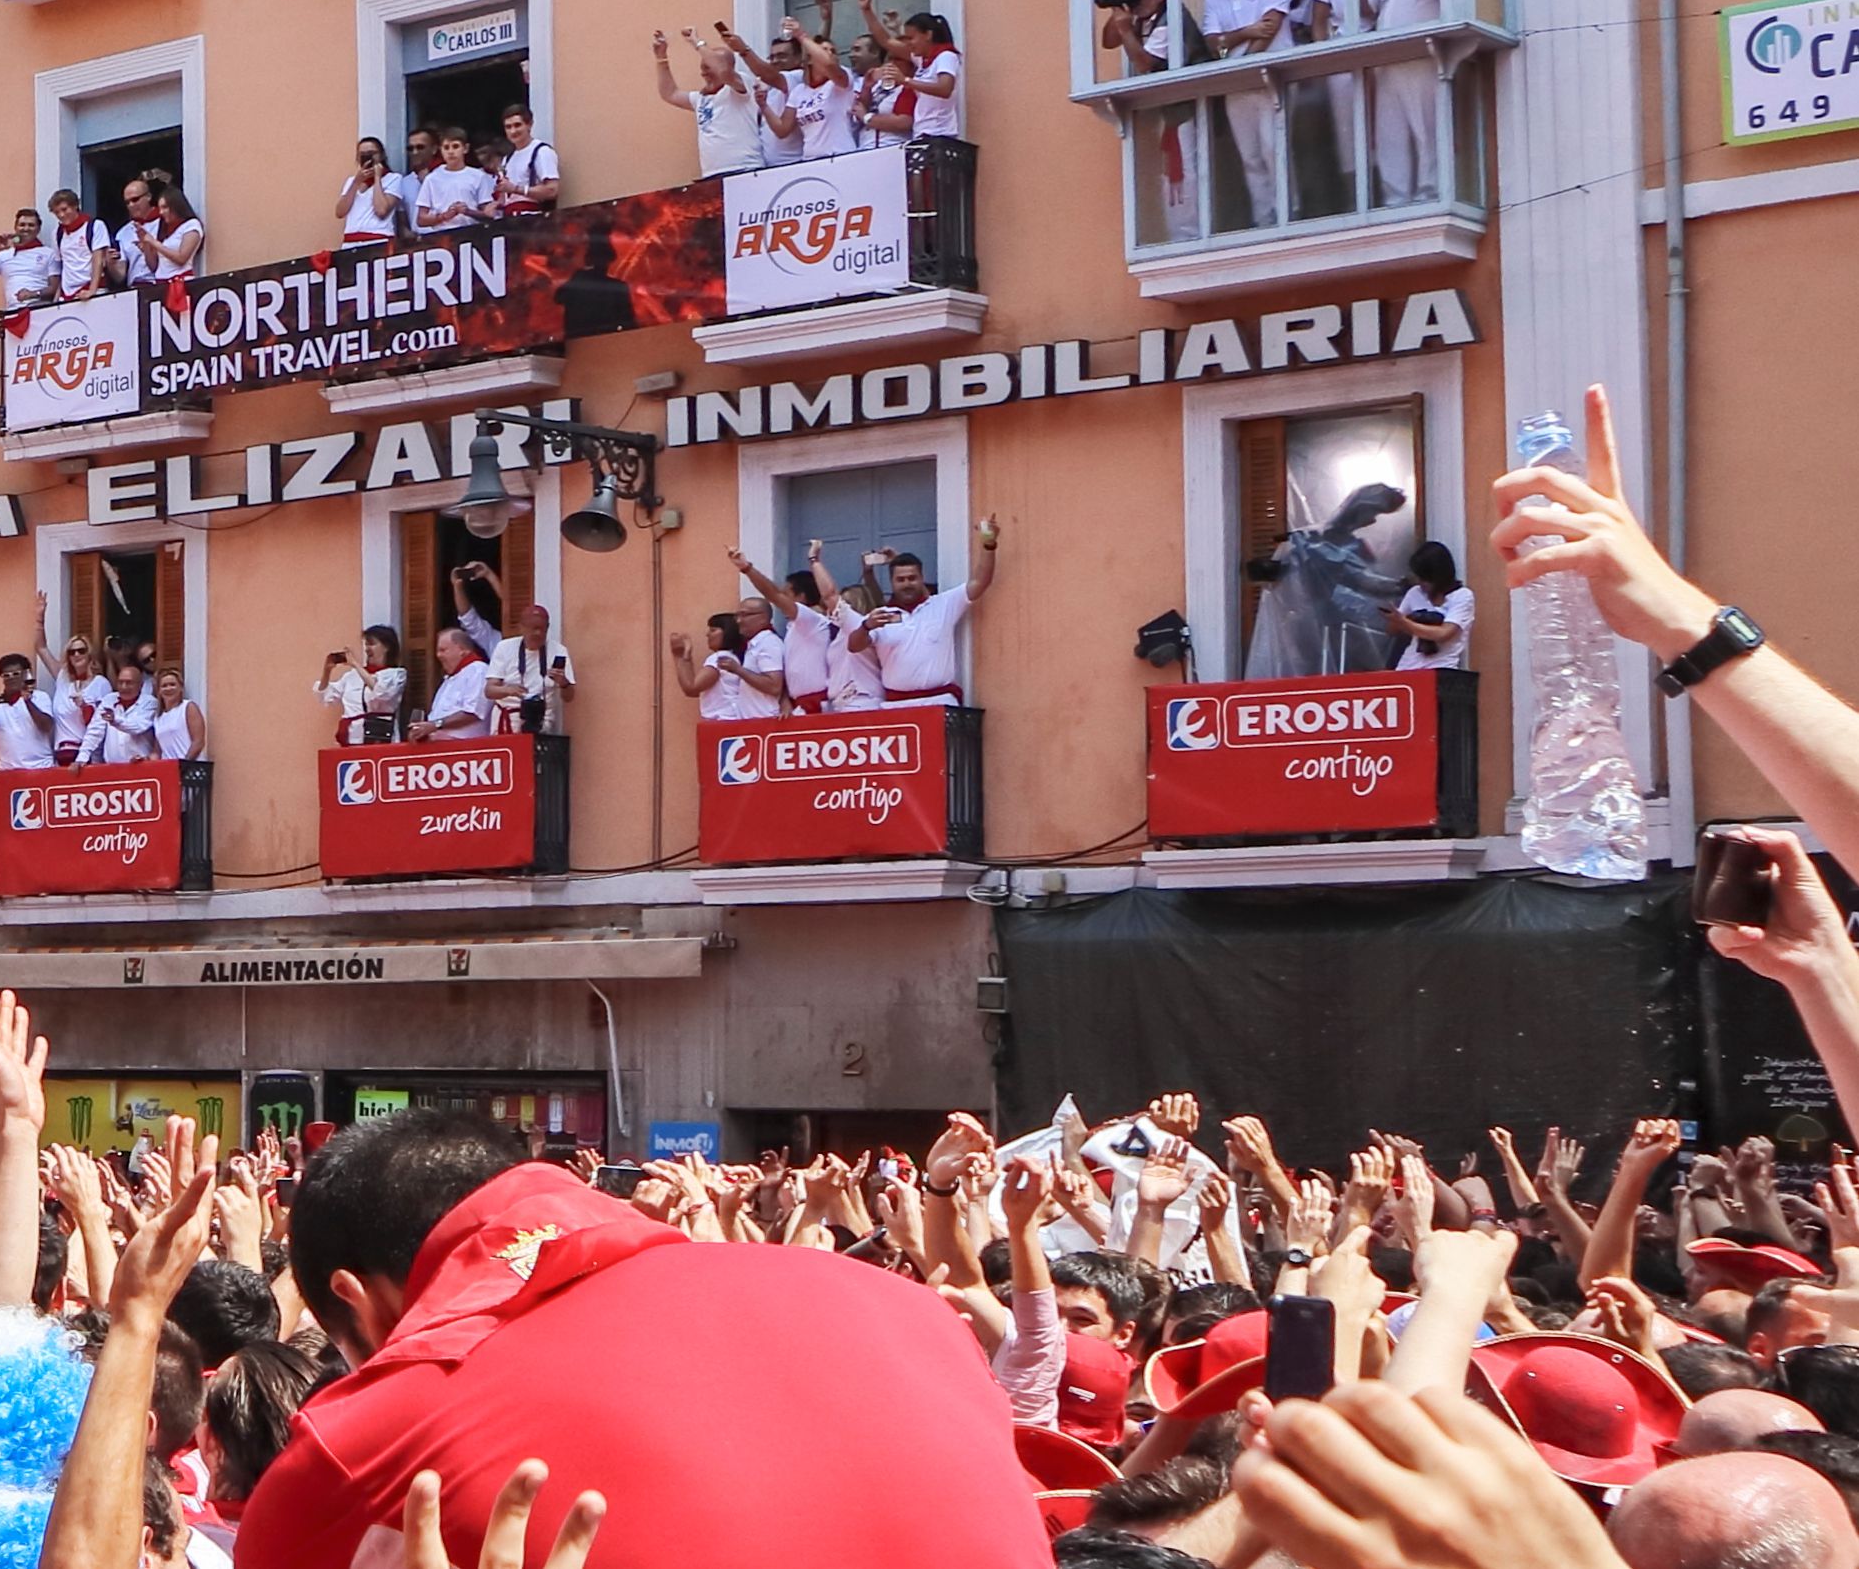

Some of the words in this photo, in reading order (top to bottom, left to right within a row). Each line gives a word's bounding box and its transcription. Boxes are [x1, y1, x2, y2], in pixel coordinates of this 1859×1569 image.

[448, 26, 497, 52] CARLOS
[500, 22, 513, 40] III
[738, 197, 837, 228] Luminosos
[732, 205, 875, 265] ARGA
[833, 239, 902, 275] digital
[149, 235, 508, 360] NORTHERN
[16, 332, 89, 359] Luminosos
[150, 353, 243, 397] SPAIN
[251, 321, 459, 380] TRAVEL.com
[11, 340, 115, 391] ARGA
[667, 288, 1477, 448] INMOBILIARIA
[84, 368, 135, 402] digital
[1238, 697, 1401, 738] EROSKI
[775, 734, 909, 773] EROSKI
[1284, 746, 1394, 797] contigo
[386, 758, 503, 797] EROSKI
[53, 787, 154, 822] EROSKI
[419, 803, 502, 834] zurekin
[813, 782, 903, 825] contigo
[82, 825, 149, 863] contigo
[200, 952, 384, 983] ALIMENTACIÓN
[841, 1042, 865, 1077] 2
